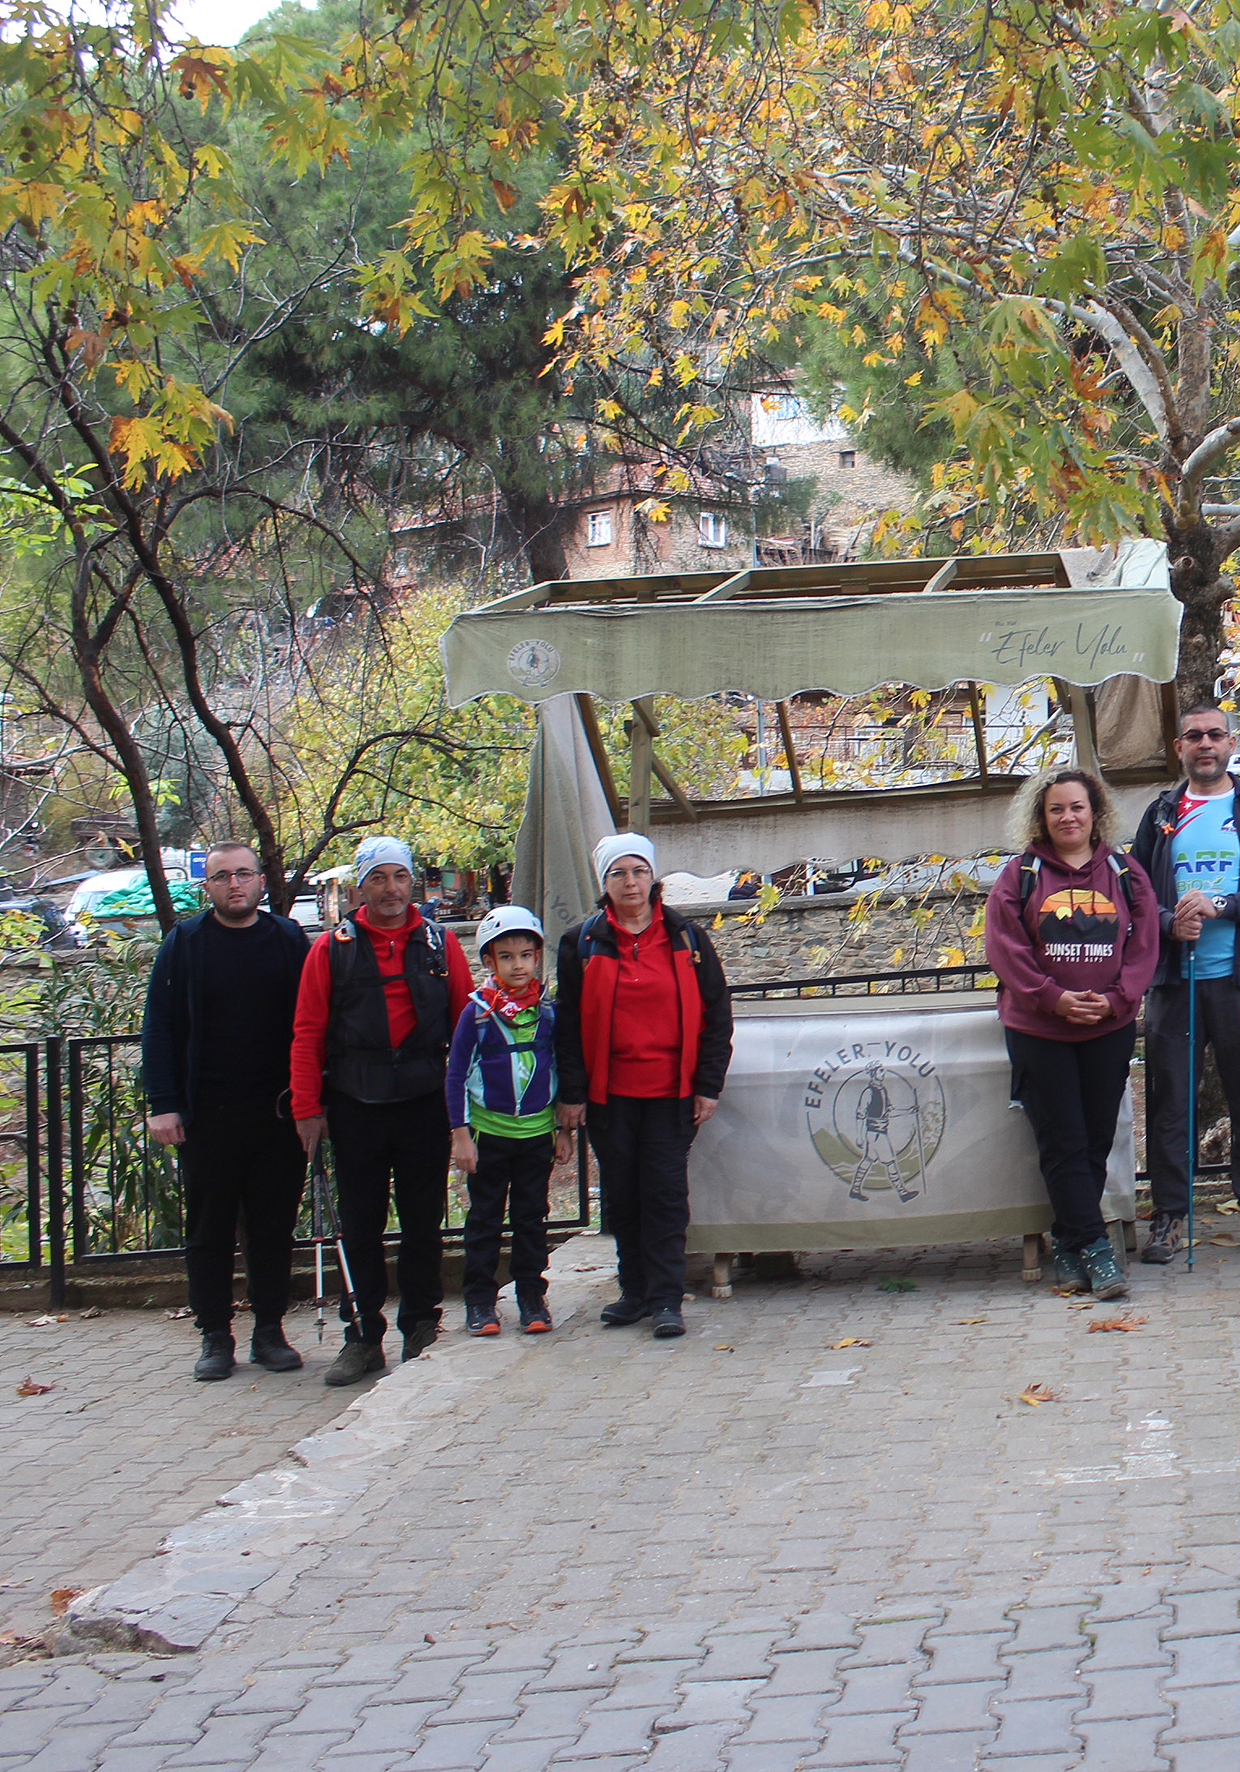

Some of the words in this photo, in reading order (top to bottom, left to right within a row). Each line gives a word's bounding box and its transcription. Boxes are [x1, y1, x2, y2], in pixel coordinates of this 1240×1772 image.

[991, 626, 1065, 667] Efeler
[1075, 622, 1128, 670] Yolu
[1044, 943, 1083, 957] SUNSET
[1083, 943, 1114, 957] TIMES
[805, 1043, 866, 1109] EFELER
[884, 1040, 936, 1078] YOLU
